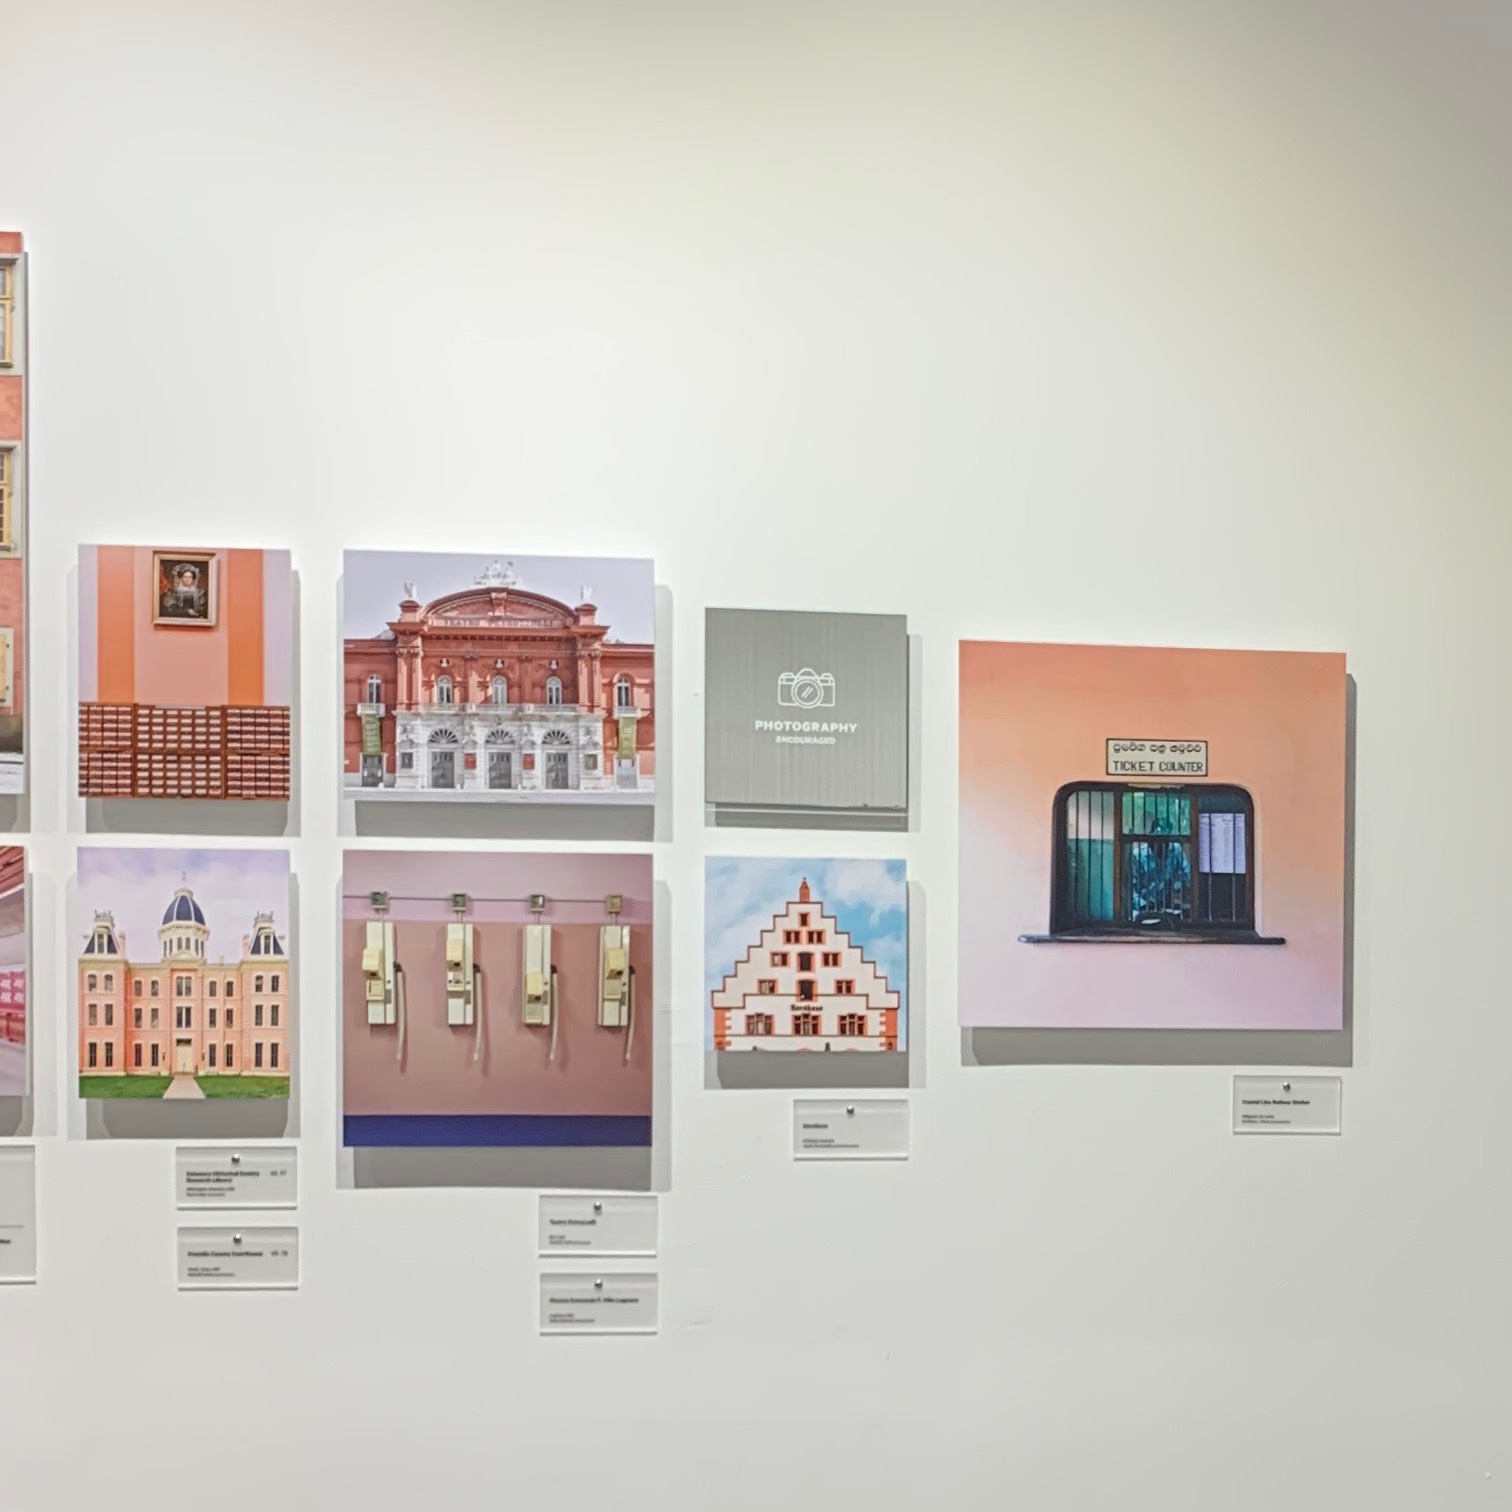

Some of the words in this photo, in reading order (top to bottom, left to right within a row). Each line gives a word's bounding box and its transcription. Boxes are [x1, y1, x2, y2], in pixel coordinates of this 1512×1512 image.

[754, 720, 858, 733] PHOTOGRAPHY
[776, 735, 836, 745] ENCOURAGED
[1113, 760, 1155, 772] TICKET
[1159, 761, 1204, 772] COUNTER
